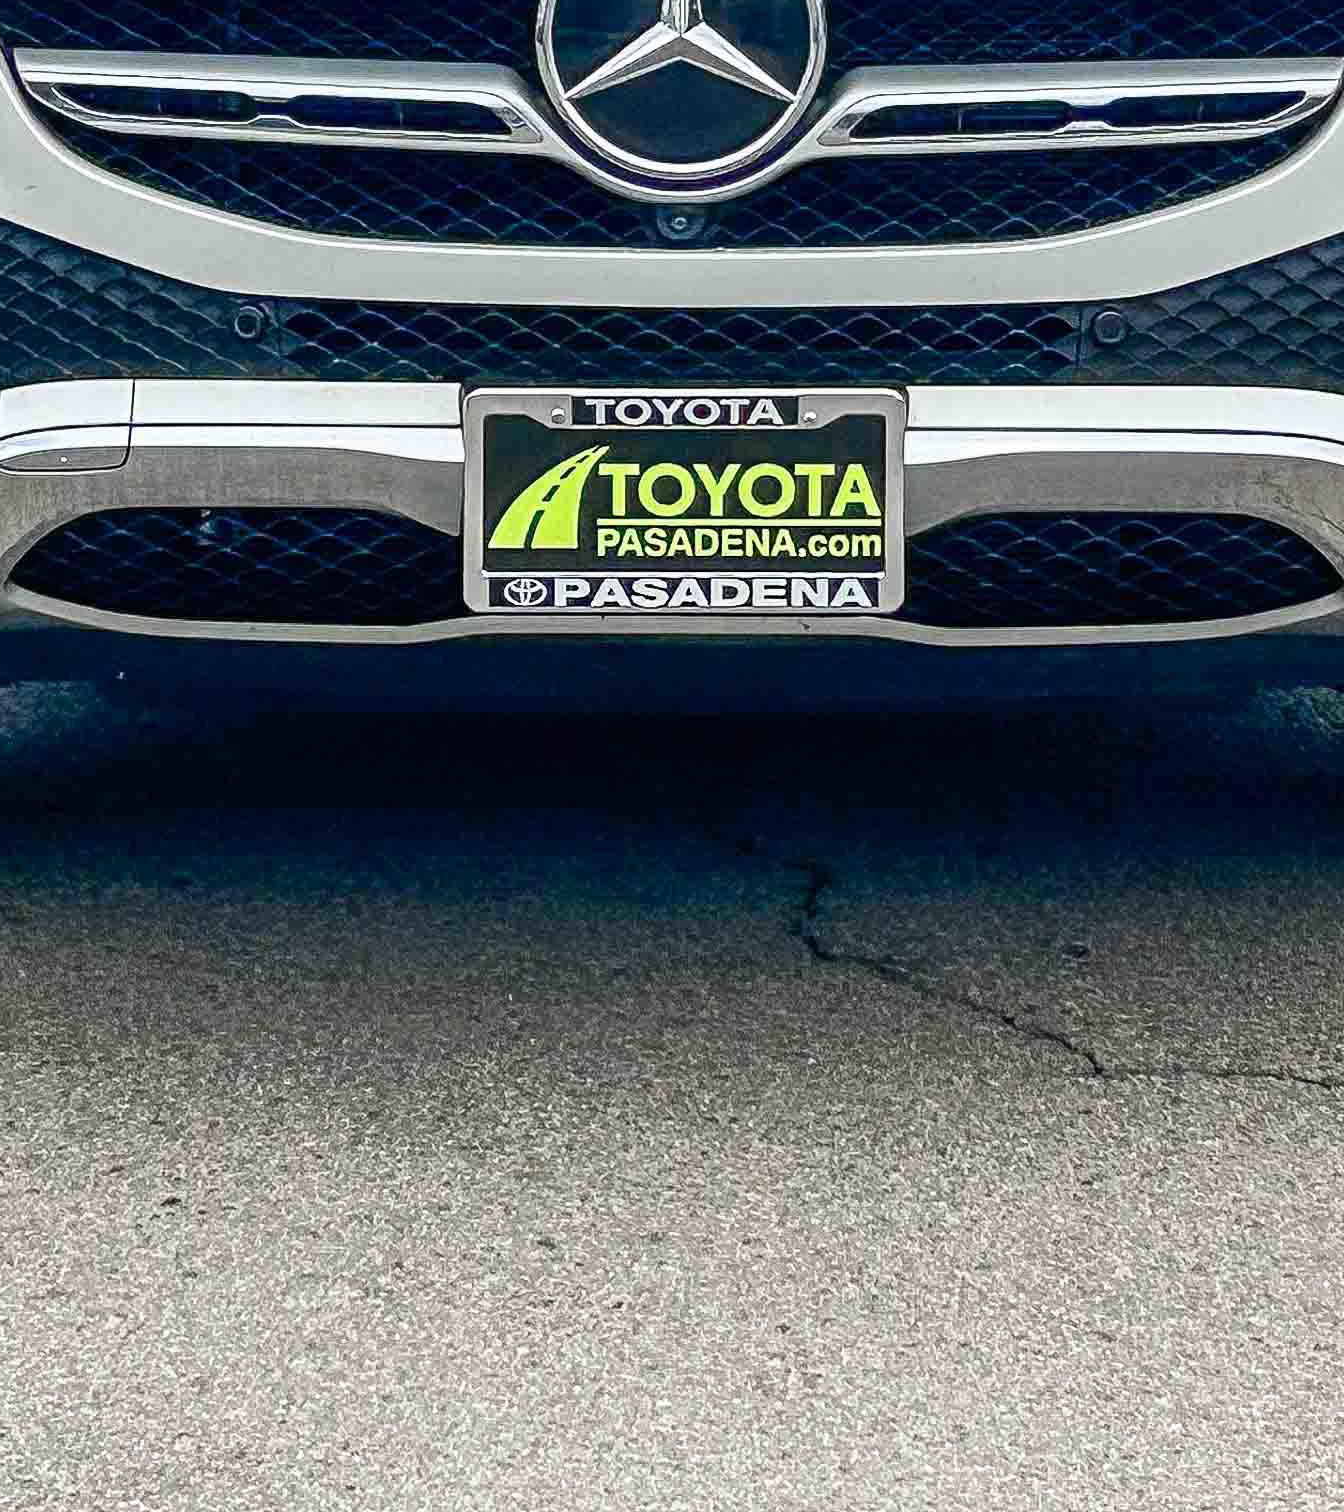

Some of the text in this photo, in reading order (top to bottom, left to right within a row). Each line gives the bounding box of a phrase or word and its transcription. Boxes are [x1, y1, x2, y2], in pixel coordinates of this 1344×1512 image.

[585, 398, 784, 426] TOYOTA
[598, 462, 882, 518] TOYOTA
[597, 527, 882, 557] PASADENA.com
[554, 577, 873, 607] PASADENA
